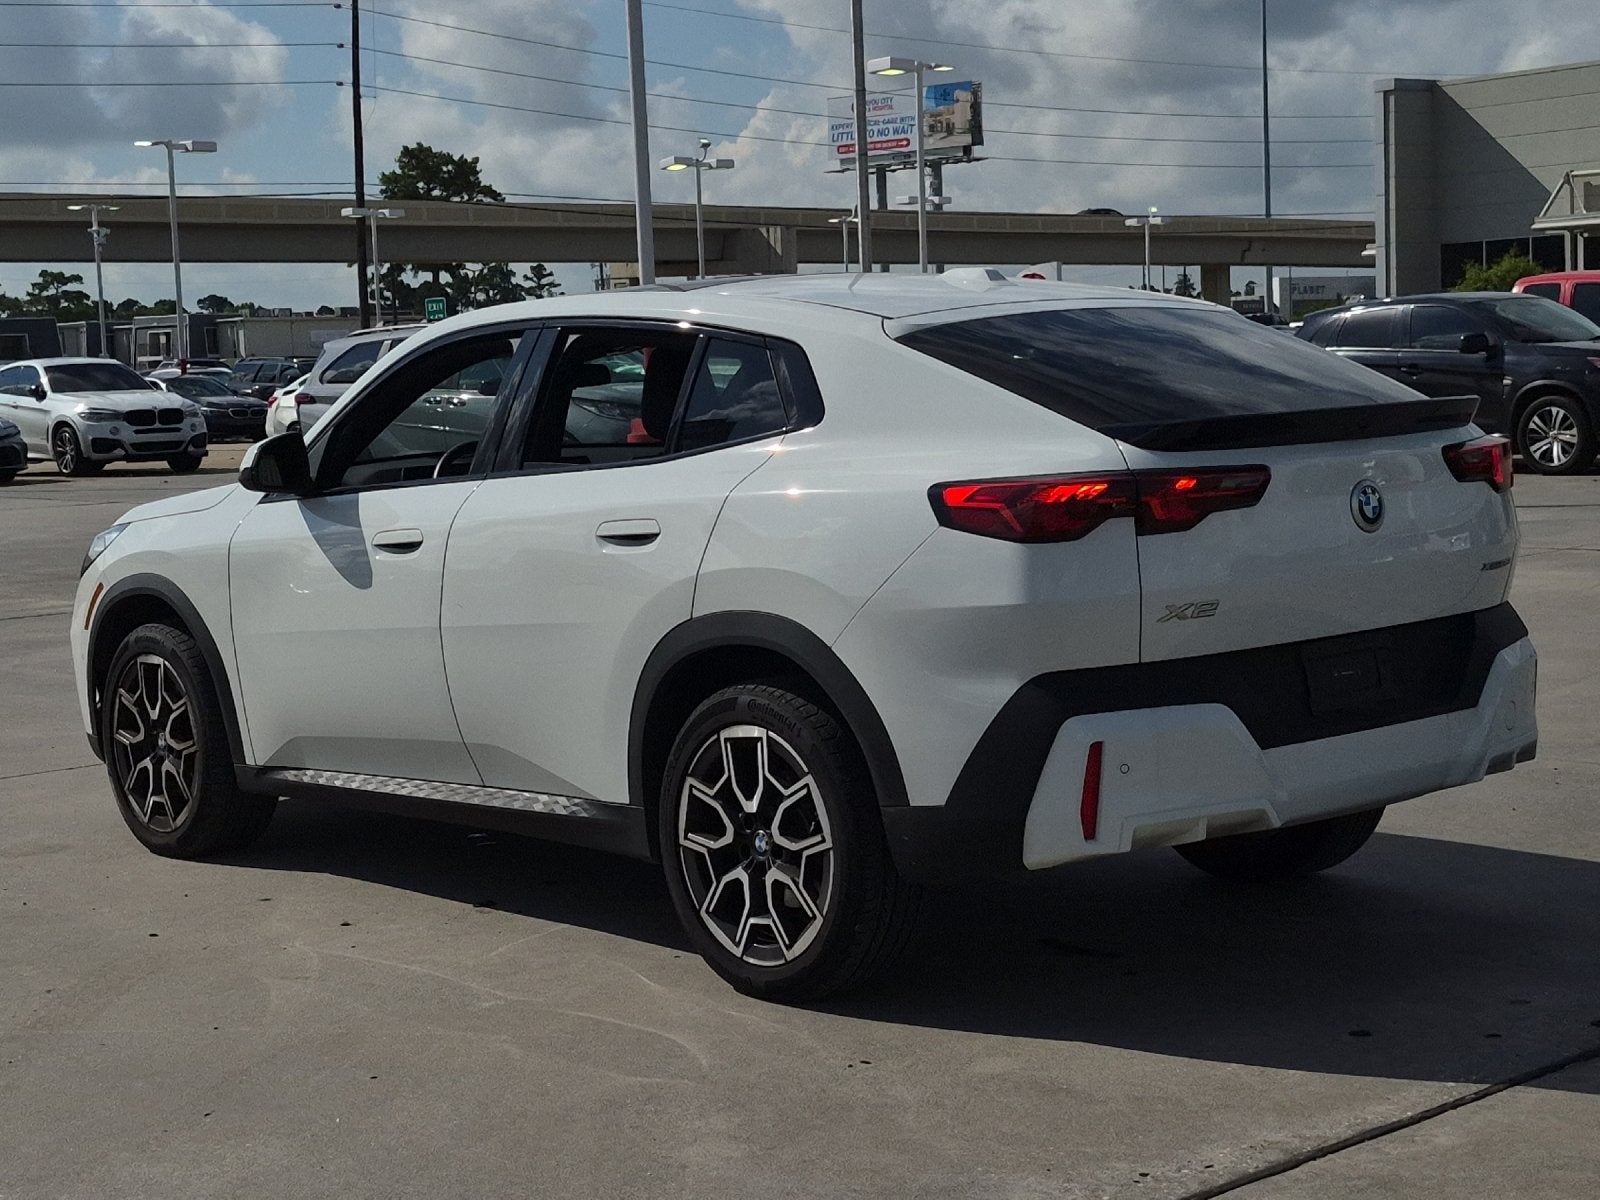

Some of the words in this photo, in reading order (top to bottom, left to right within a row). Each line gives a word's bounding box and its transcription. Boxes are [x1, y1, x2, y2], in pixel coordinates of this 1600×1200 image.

[831, 122, 854, 131] EXPERT
[832, 131, 856, 143] LITTL
[877, 126, 890, 137] NO
[892, 124, 915, 136] WAIT
[428, 302, 443, 311] EXIT
[1156, 599, 1219, 623] X2
[747, 699, 797, 732] Continental
